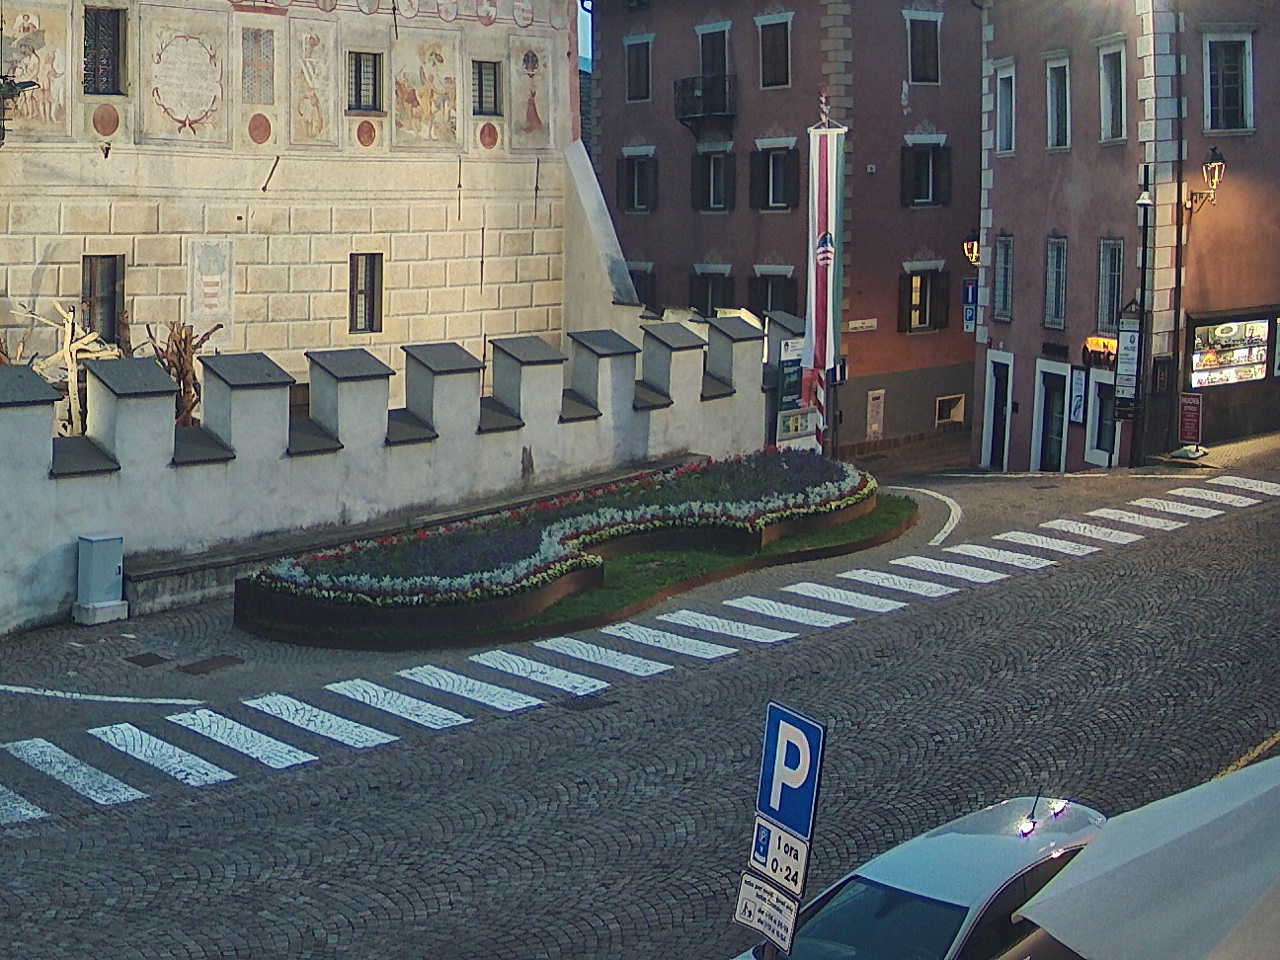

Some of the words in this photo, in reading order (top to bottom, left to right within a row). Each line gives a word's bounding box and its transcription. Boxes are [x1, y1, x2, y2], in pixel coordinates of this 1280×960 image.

[770, 720, 811, 811] P
[777, 835, 782, 850] 1
[783, 842, 799, 861] ora
